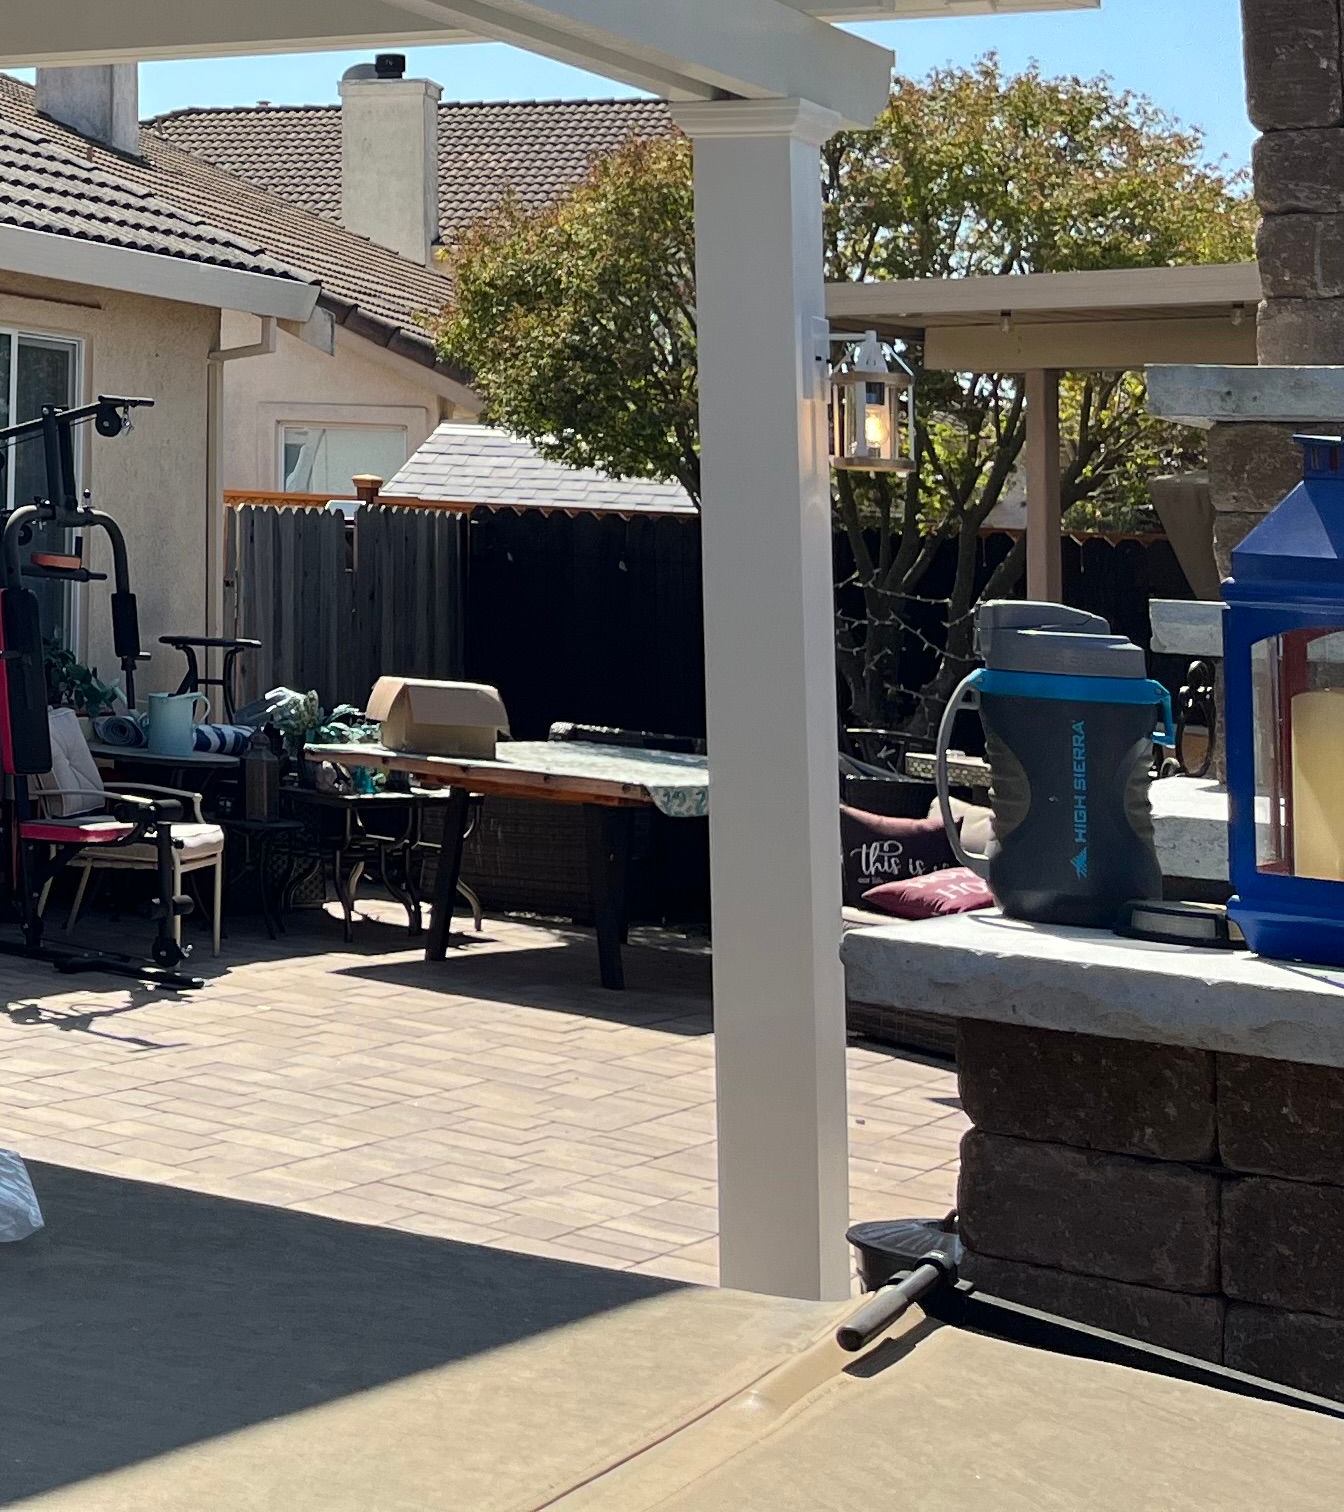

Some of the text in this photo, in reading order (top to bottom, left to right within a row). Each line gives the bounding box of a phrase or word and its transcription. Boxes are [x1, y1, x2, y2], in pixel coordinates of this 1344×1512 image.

[1072, 720, 1088, 843] HIGH SIERRA
[850, 840, 926, 876] this is
[934, 881, 988, 900] HO
